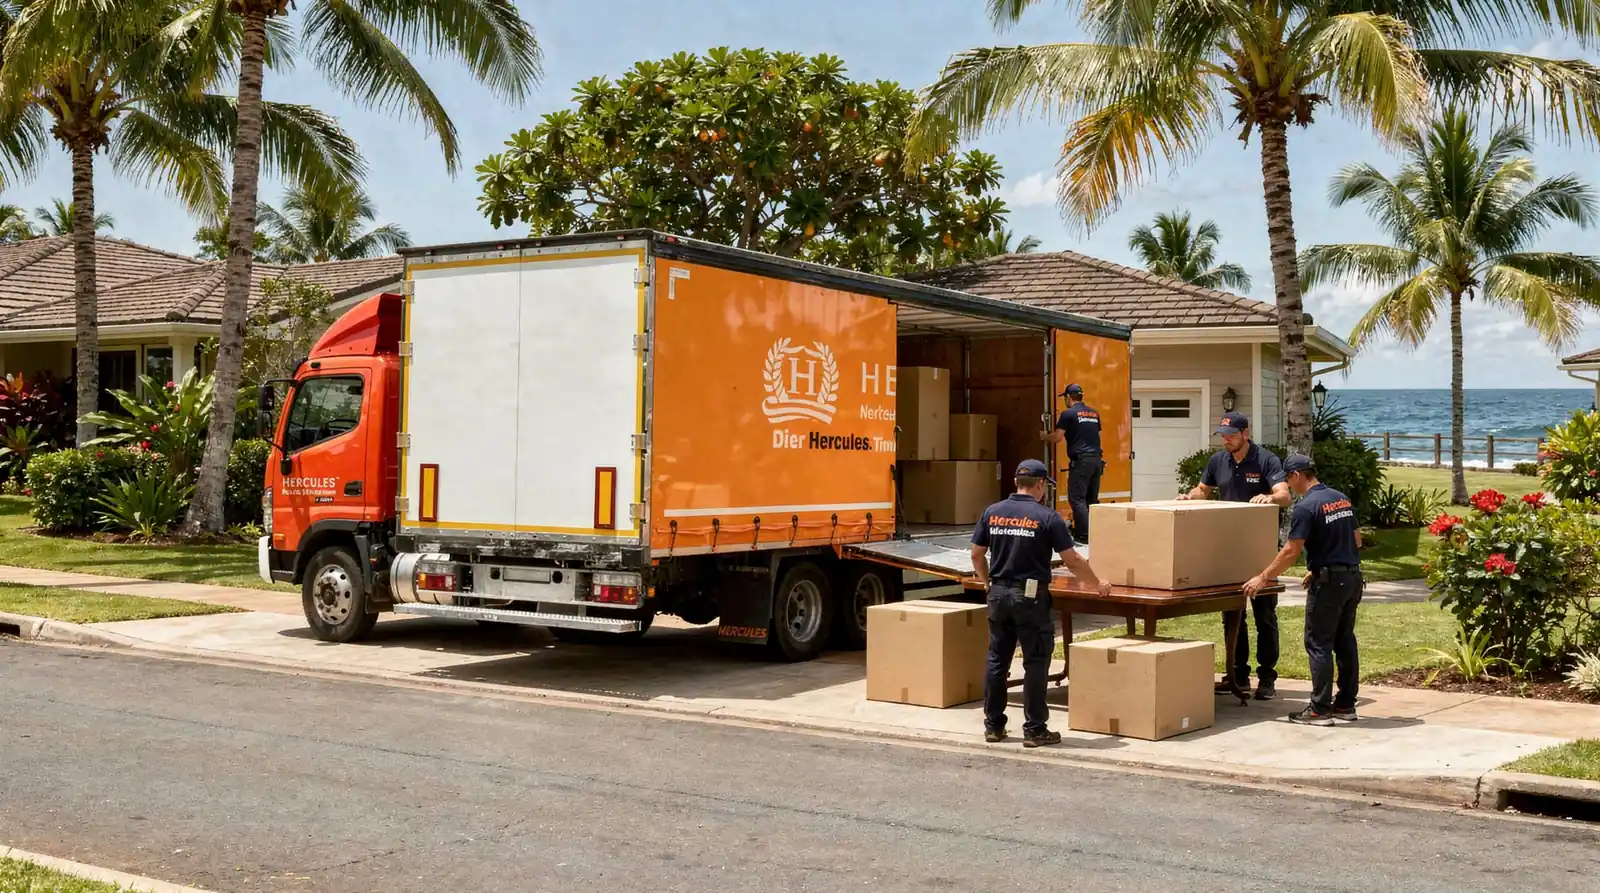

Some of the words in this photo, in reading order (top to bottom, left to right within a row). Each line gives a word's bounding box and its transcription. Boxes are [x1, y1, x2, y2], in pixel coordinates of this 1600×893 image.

[788, 357, 817, 395] H
[862, 362, 897, 396] HE
[773, 429, 805, 448] Dier
[809, 431, 872, 451] Hercules.
[989, 516, 1039, 529] Hercules
[719, 625, 767, 638] HERCULES
